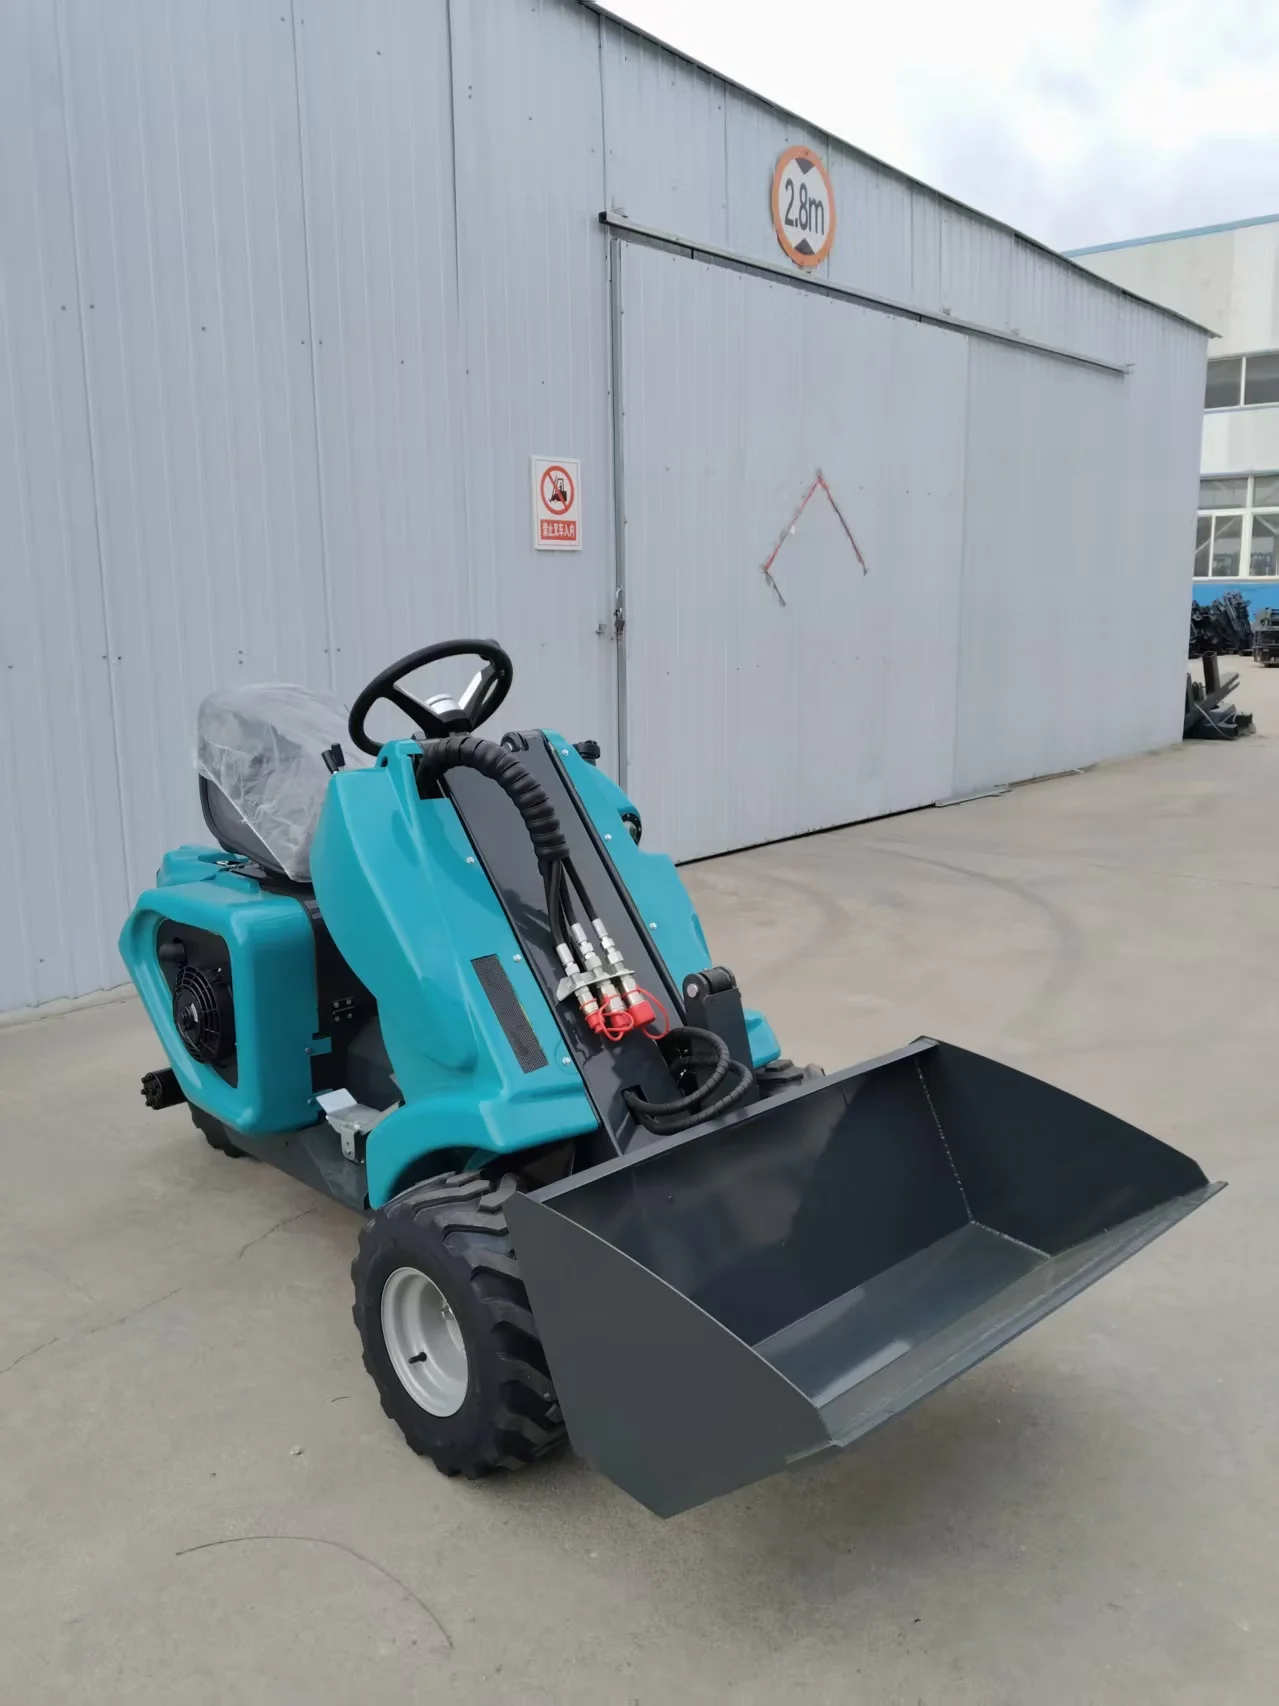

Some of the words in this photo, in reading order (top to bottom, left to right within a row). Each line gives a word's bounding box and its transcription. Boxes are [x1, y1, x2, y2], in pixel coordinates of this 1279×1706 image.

[784, 177, 824, 235] 2.8m
[543, 522, 575, 538] 禁止叉车入内
